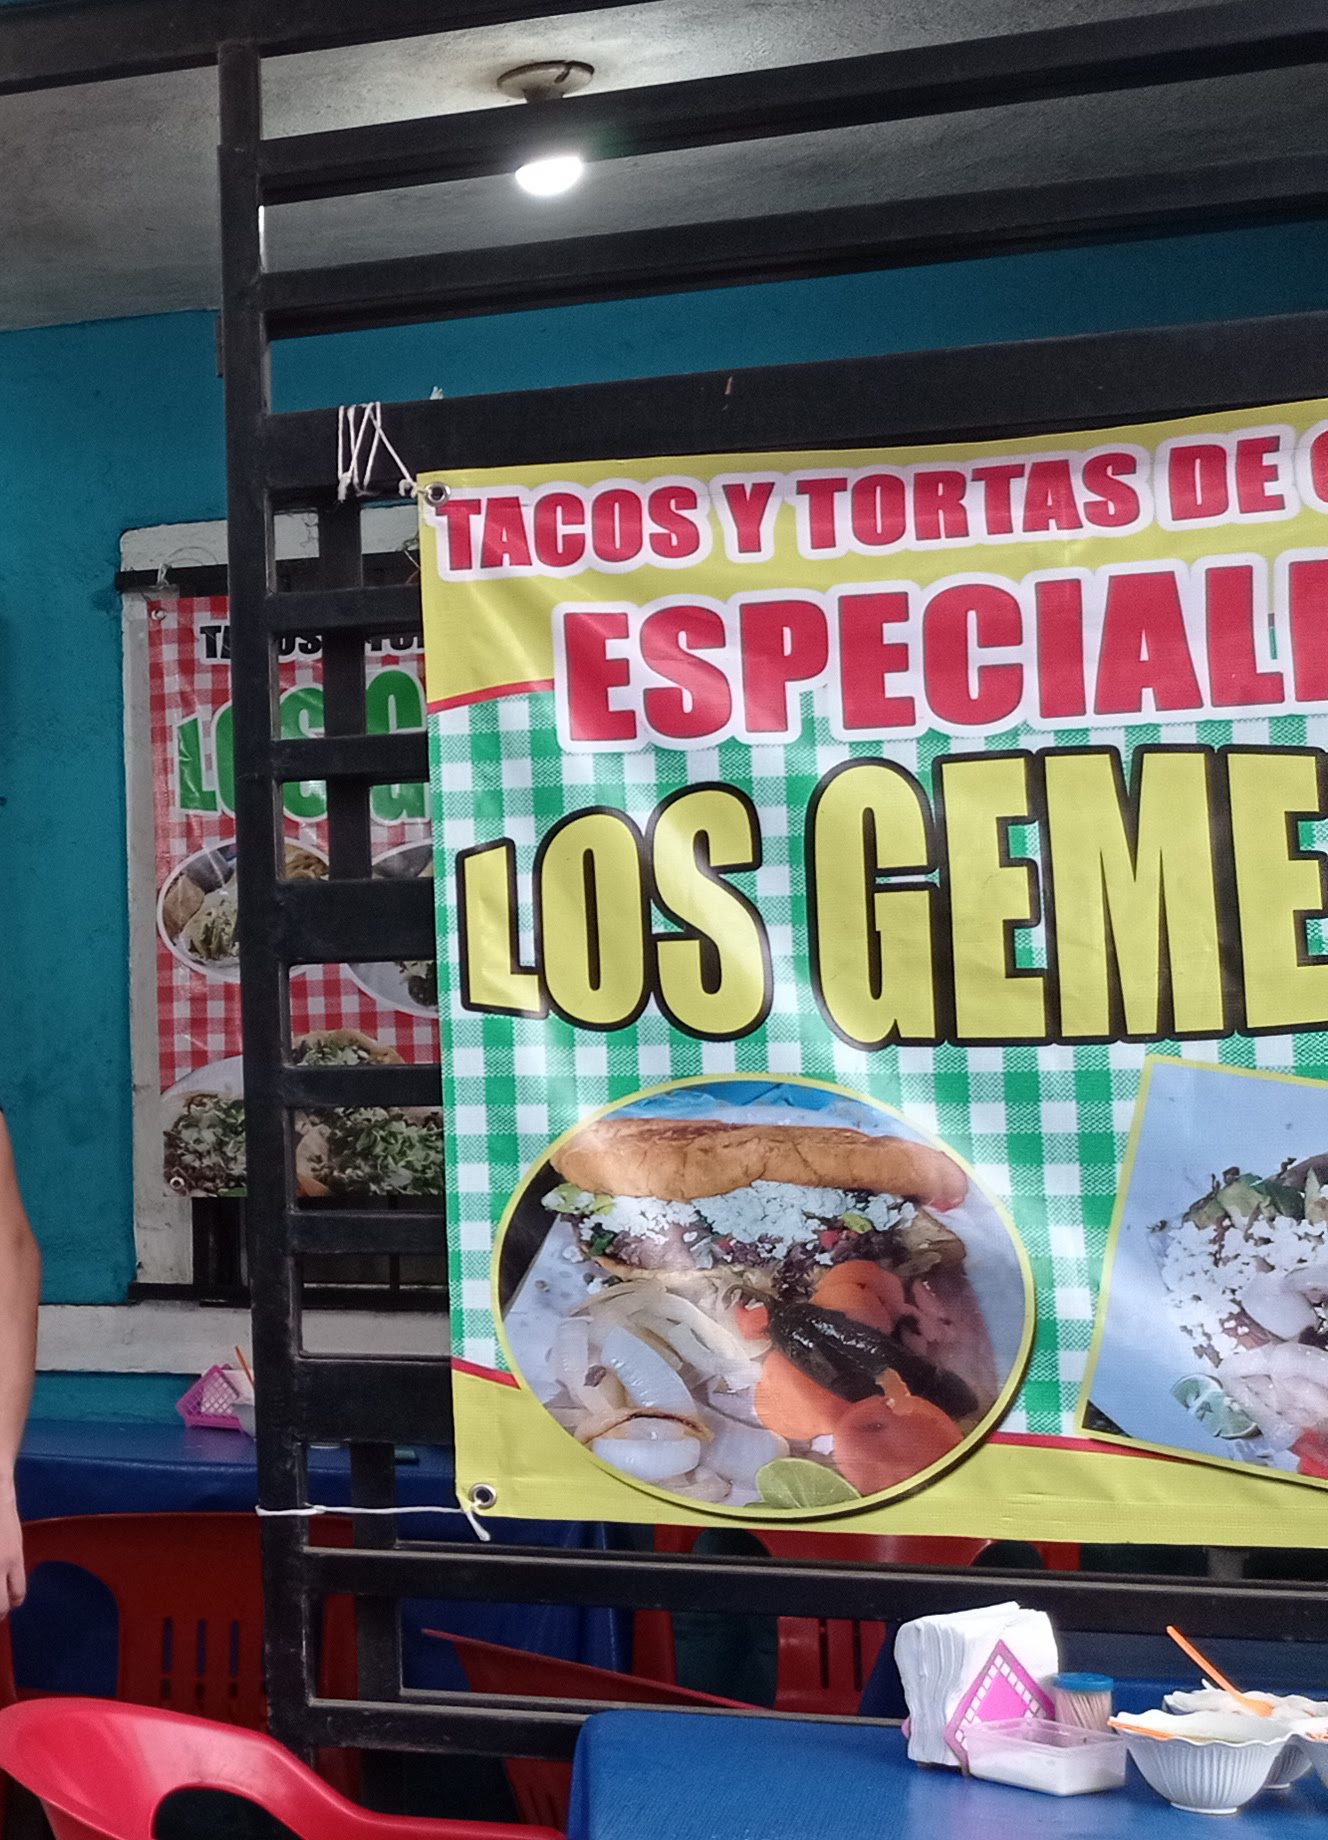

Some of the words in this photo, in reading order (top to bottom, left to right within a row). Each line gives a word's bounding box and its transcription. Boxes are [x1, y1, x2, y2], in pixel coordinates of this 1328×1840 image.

[436, 486, 699, 571] TACOS
[722, 483, 776, 554] Y
[797, 451, 1140, 550] TORTAS
[1169, 435, 1286, 521] DE
[456, 781, 773, 1042] LOS
